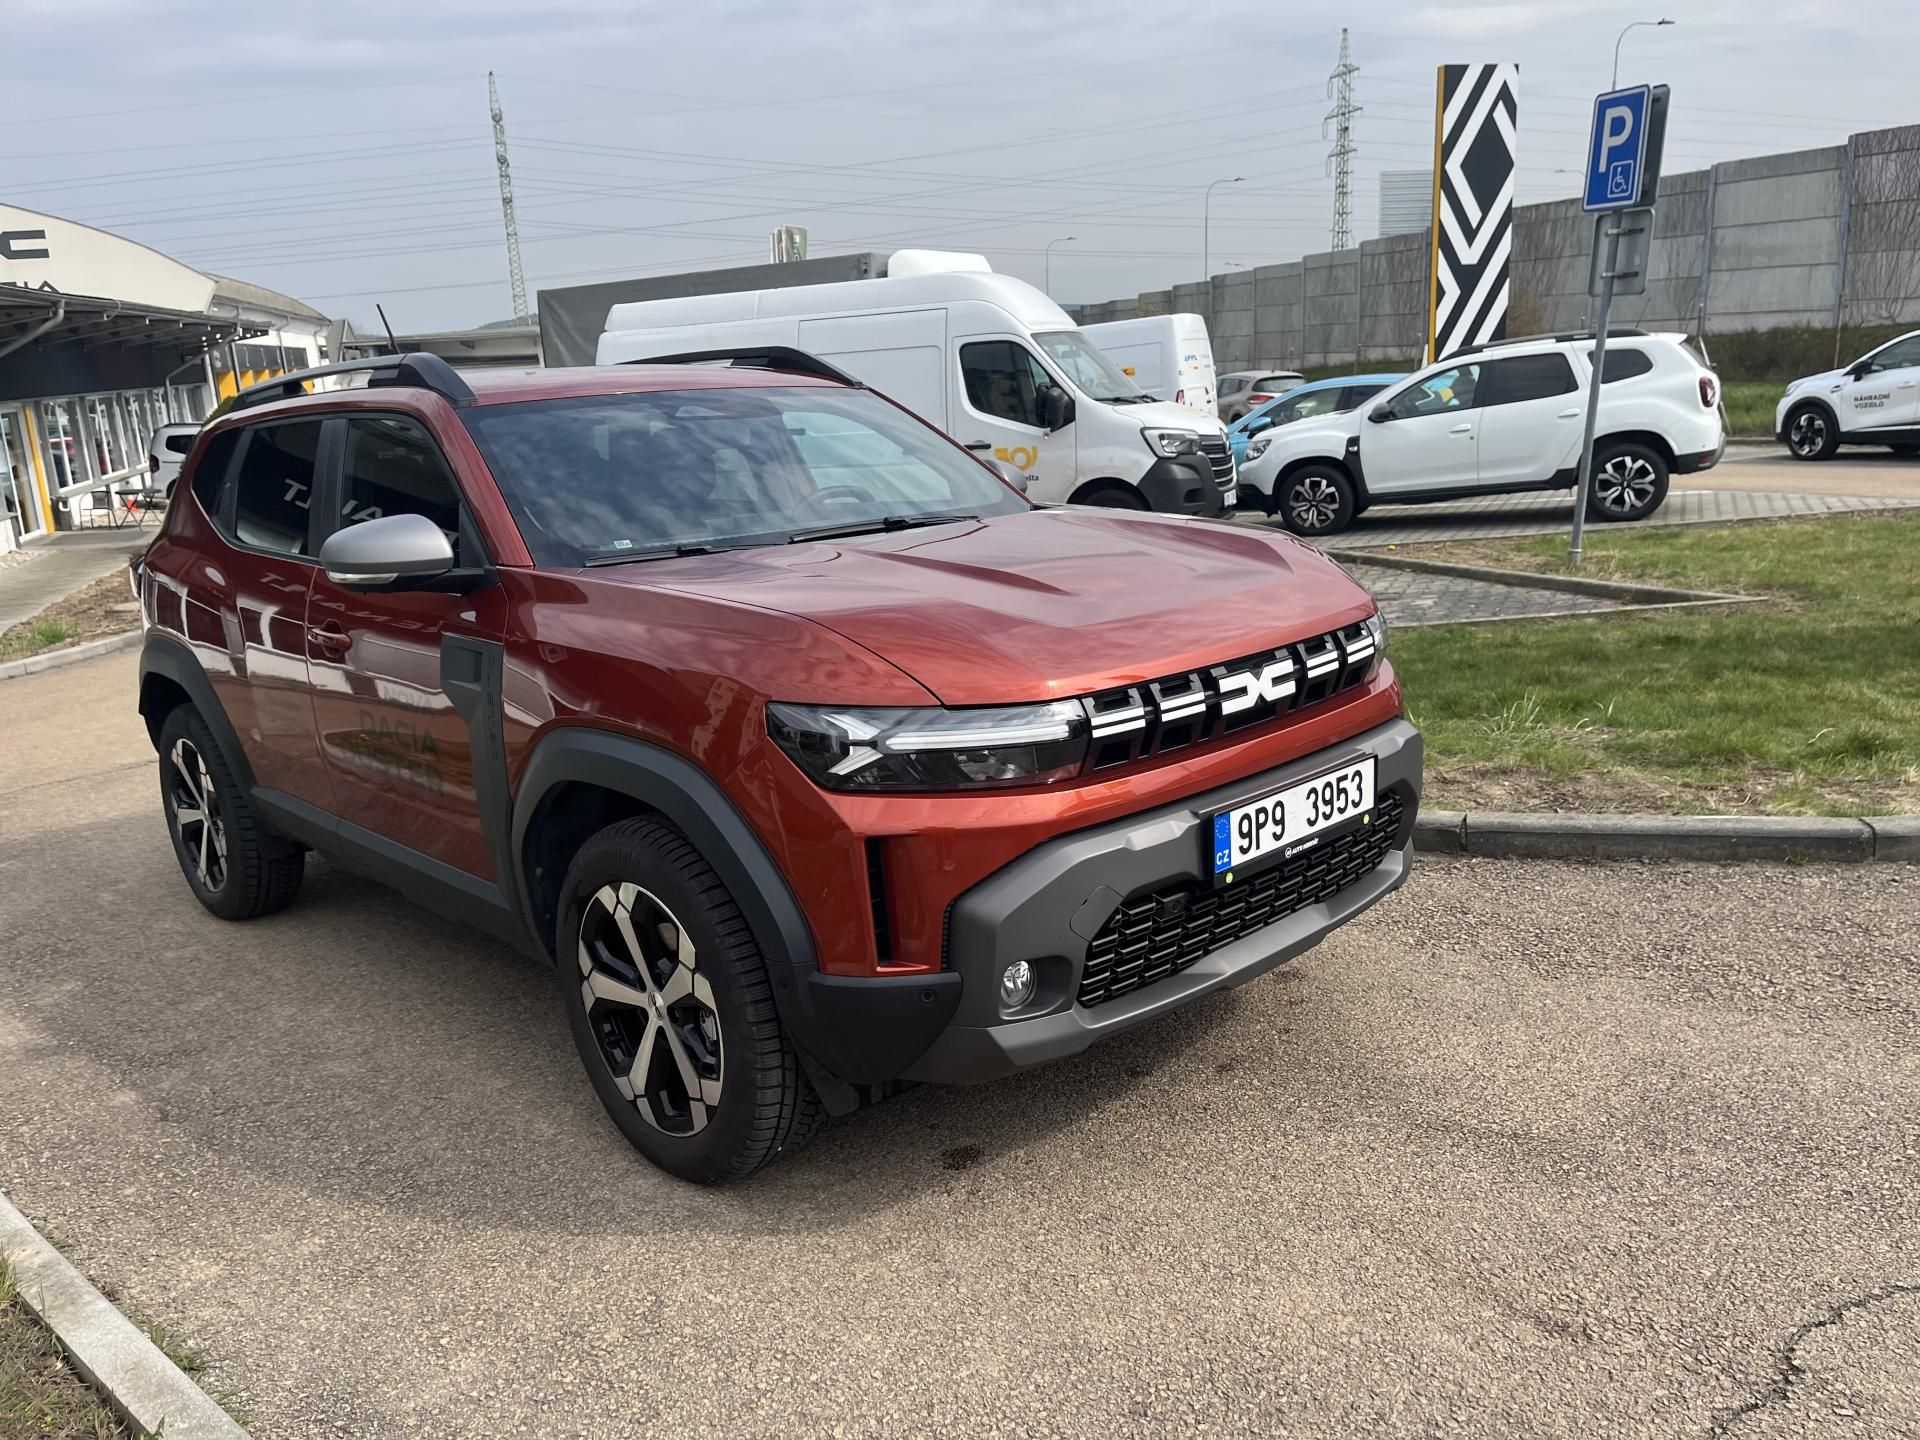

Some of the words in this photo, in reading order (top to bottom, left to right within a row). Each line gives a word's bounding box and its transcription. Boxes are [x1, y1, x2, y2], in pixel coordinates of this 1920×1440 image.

[1598, 105, 1634, 173] P
[1854, 401, 1885, 409] VOZIDLO
[1238, 800, 1285, 855] 9P9
[1306, 769, 1363, 827] 3953
[1216, 849, 1230, 865] CZ
